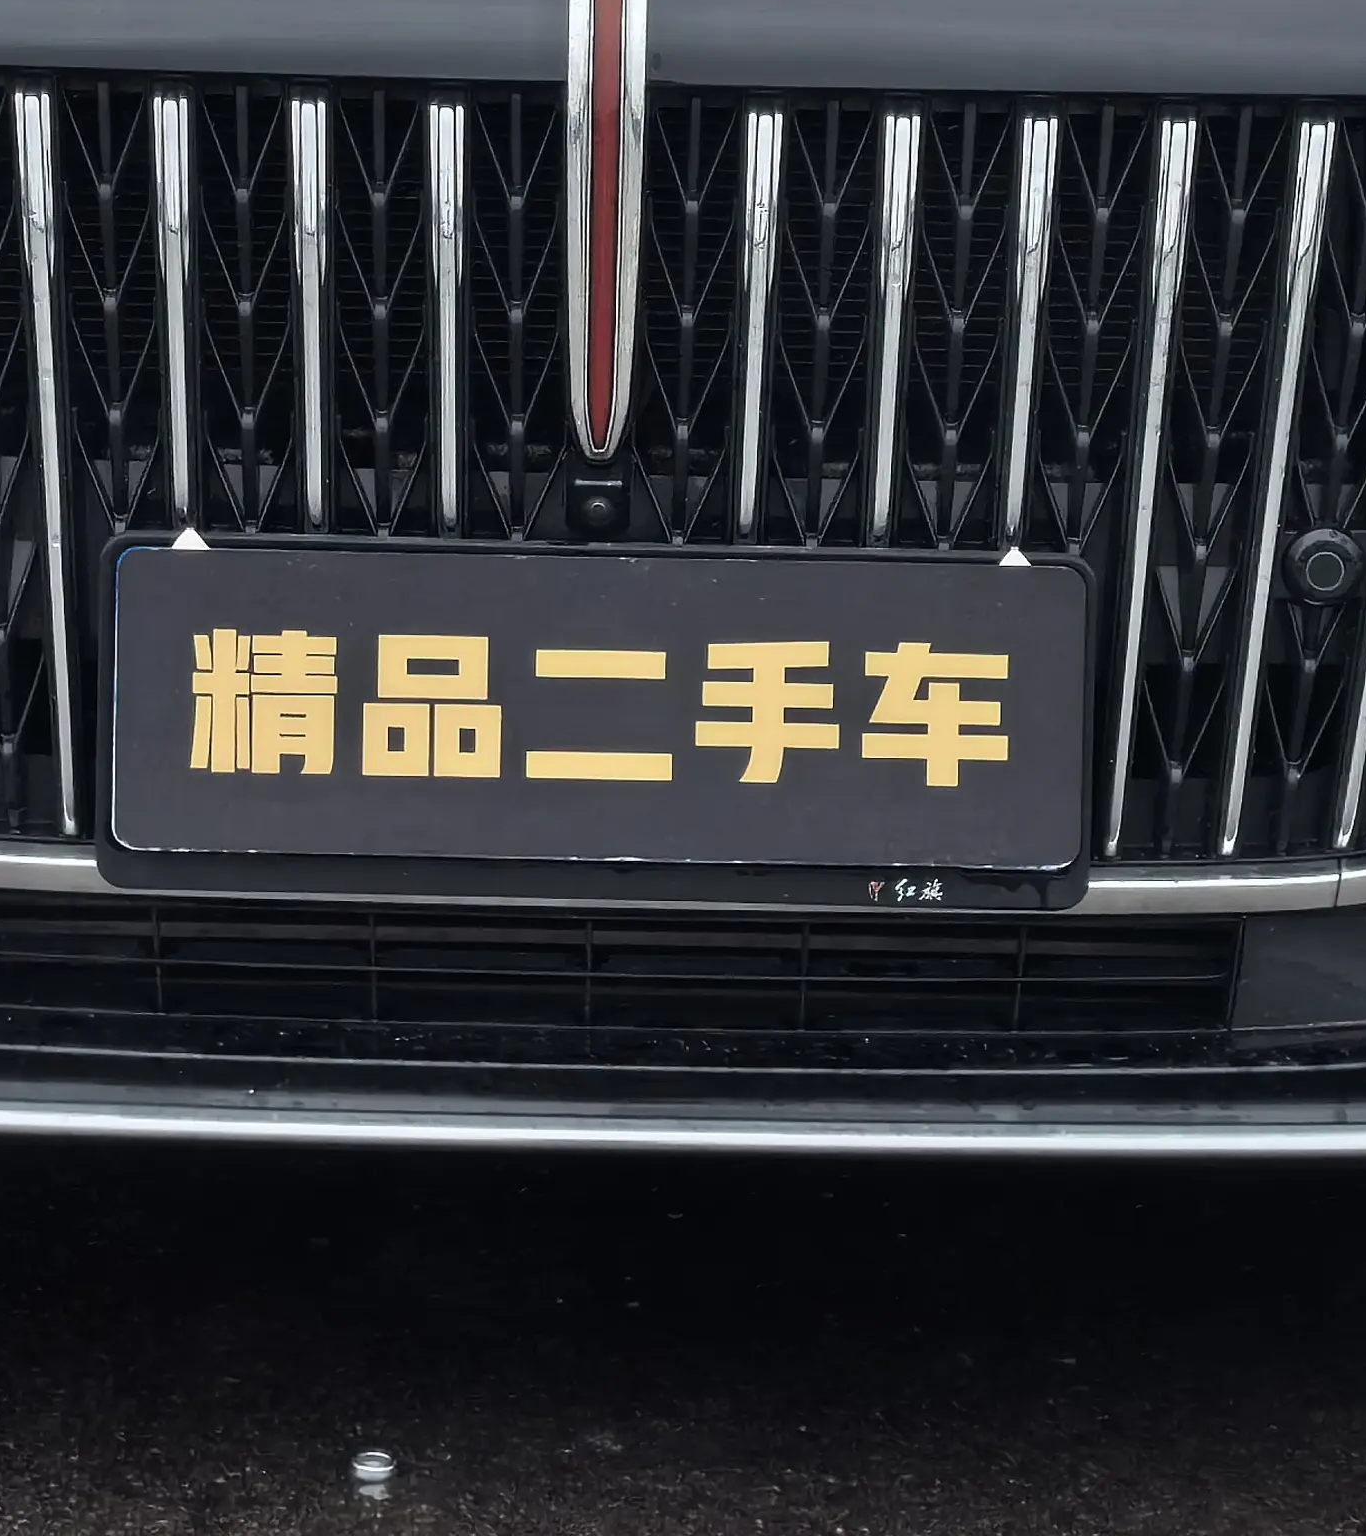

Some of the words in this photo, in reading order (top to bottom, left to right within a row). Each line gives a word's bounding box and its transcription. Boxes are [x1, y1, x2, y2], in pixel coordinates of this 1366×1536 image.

[191, 628, 1010, 787] 精品二手车
[894, 877, 944, 902] 红旗
